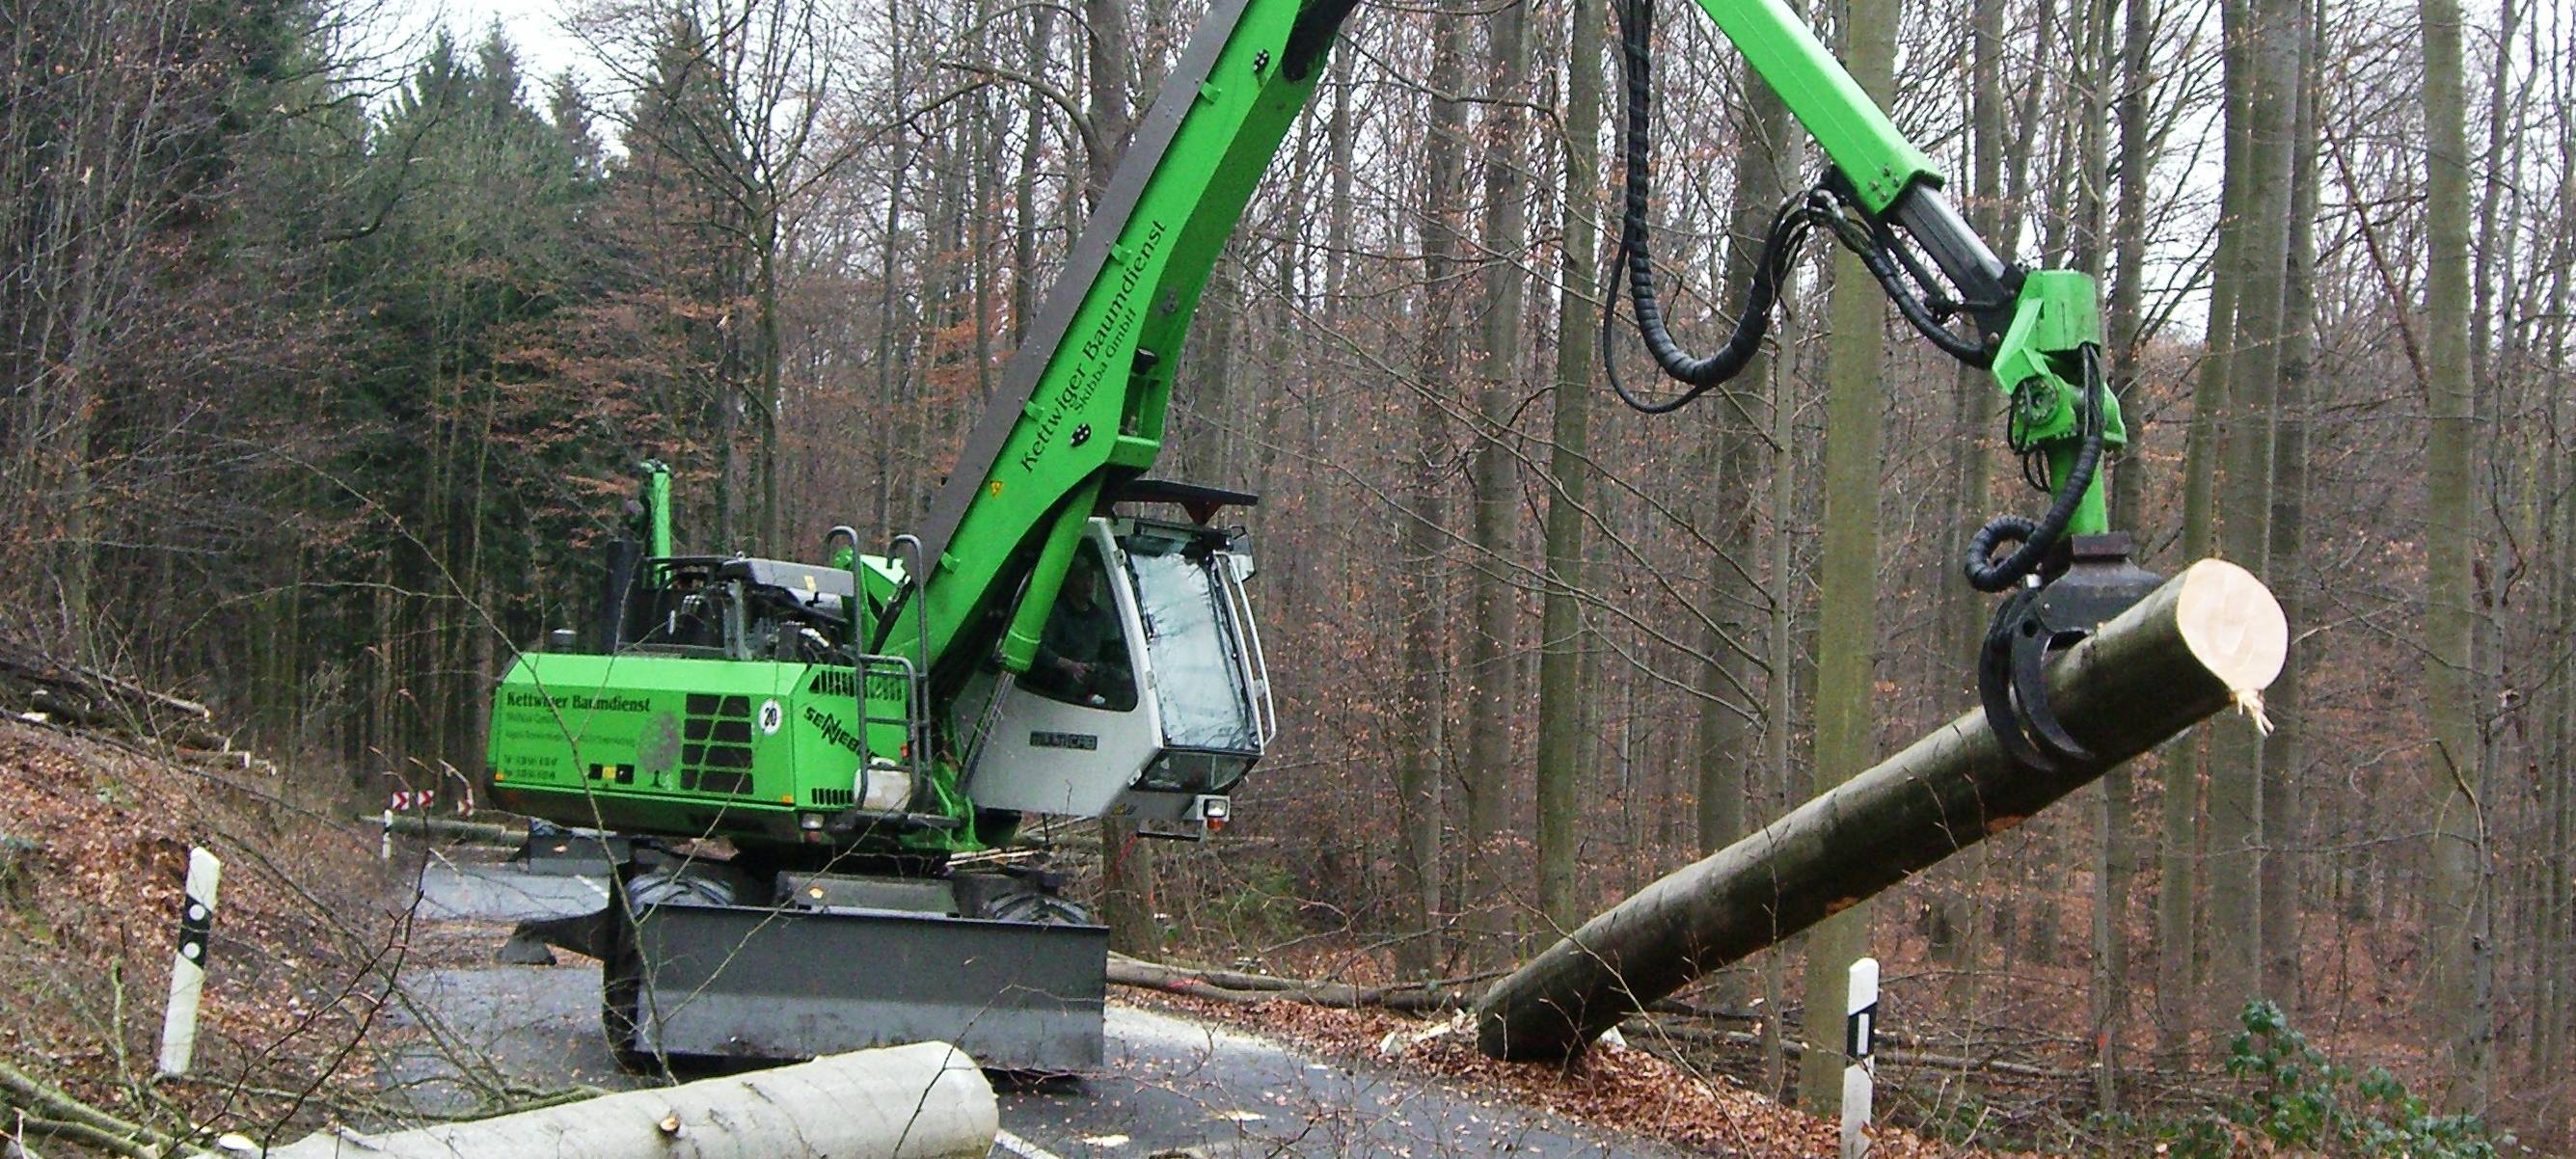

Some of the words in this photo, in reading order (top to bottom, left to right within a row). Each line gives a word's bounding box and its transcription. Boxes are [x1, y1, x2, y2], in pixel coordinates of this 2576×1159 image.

[1020, 363, 1087, 473] Kettwiger
[1082, 220, 1167, 362] Baumdienst
[1105, 308, 1137, 360] GmbH
[765, 707, 777, 726] 20
